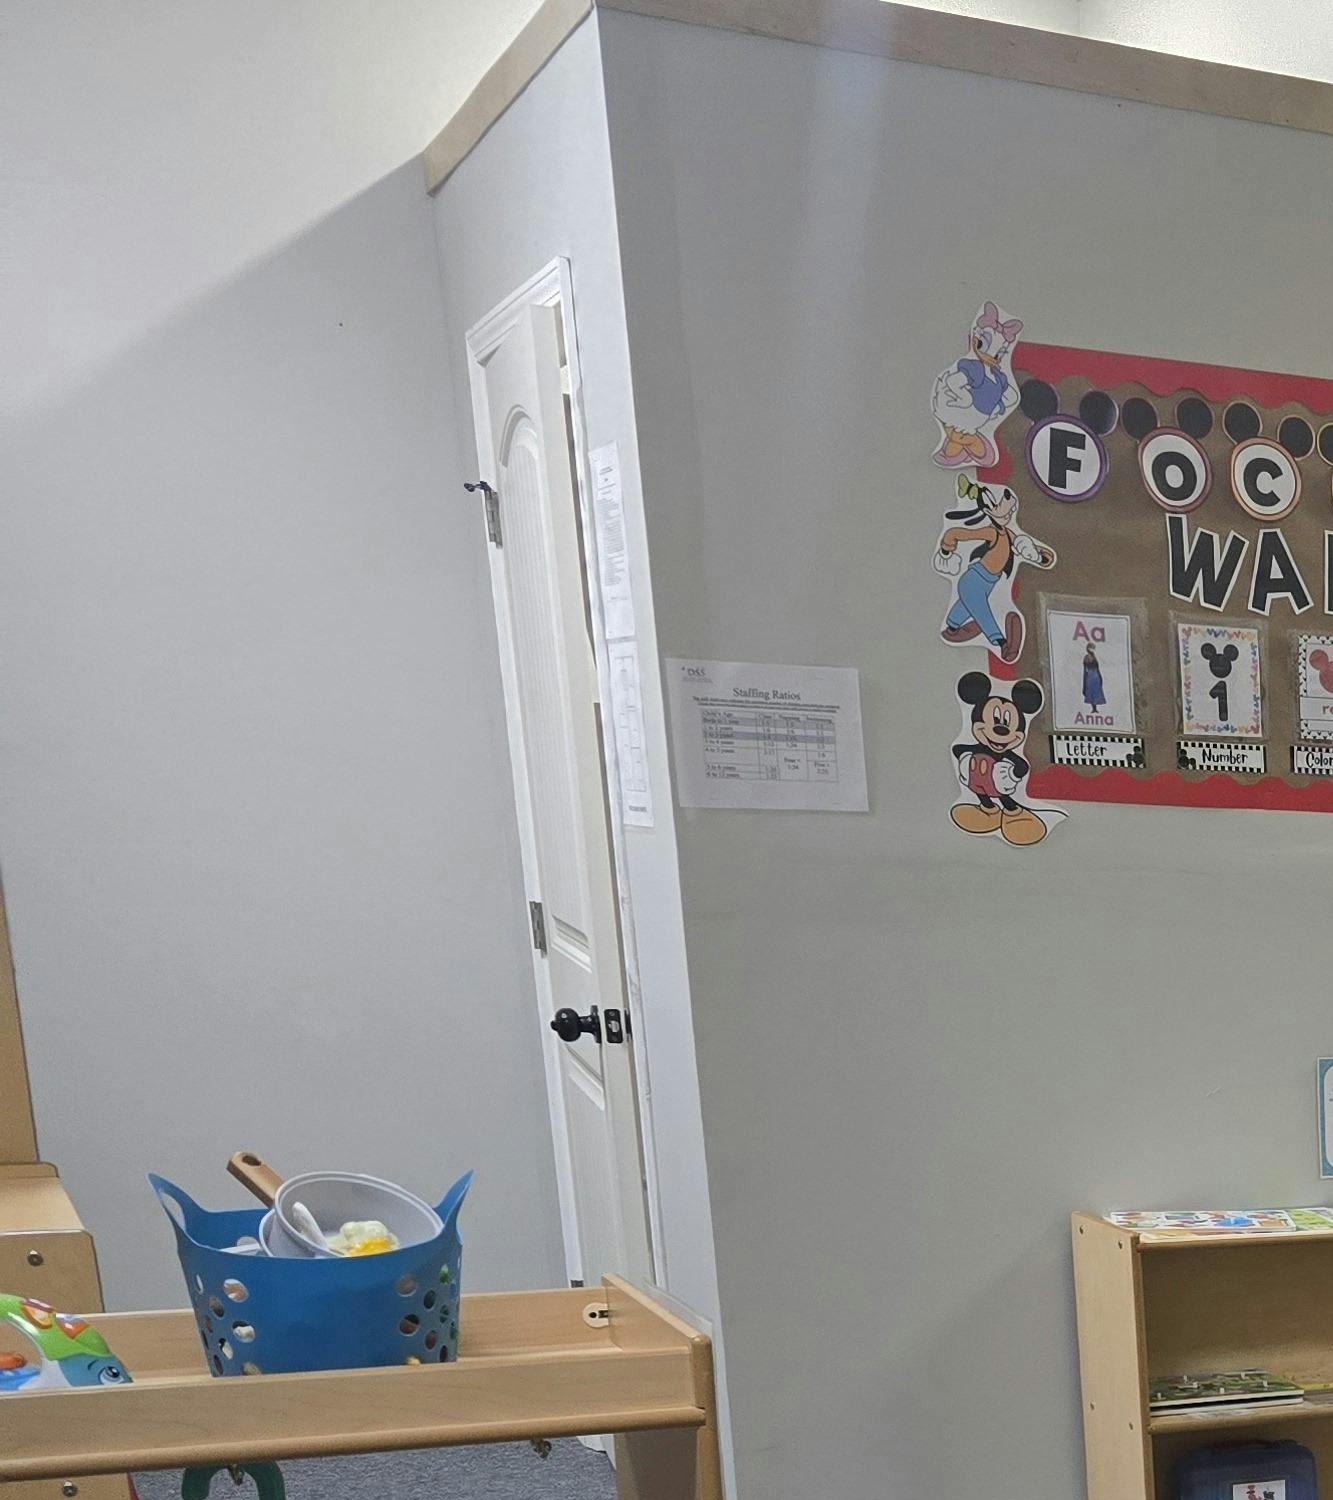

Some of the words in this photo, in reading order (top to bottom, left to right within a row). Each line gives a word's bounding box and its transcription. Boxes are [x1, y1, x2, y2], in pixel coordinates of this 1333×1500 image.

[1073, 621, 1106, 642] Aa
[732, 687, 770, 701] Staffing
[772, 689, 801, 701] Ratios
[1208, 680, 1228, 721] 1
[1074, 712, 1114, 726] Anna
[1066, 742, 1108, 757] Letter
[1201, 749, 1249, 765] Number
